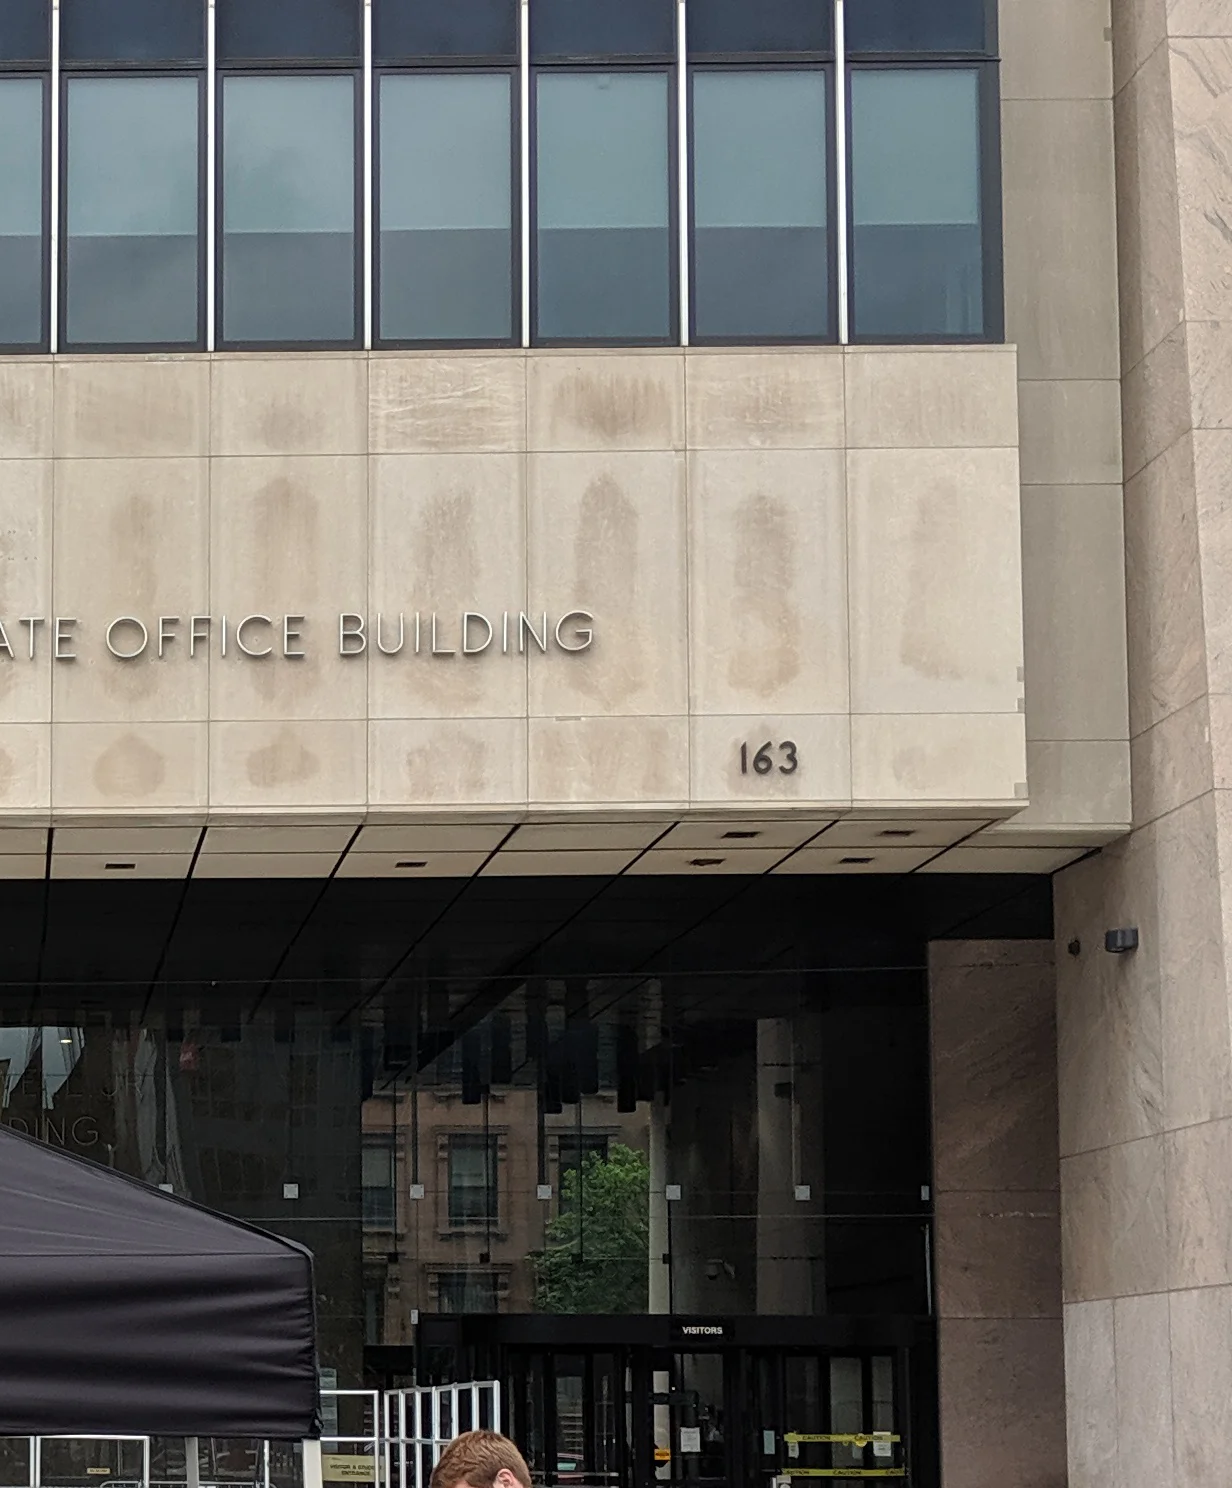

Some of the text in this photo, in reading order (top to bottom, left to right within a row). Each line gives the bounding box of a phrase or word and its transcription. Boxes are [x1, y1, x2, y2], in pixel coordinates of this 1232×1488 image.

[106, 614, 306, 659] OFFICE
[339, 610, 596, 656] BUILDING
[741, 741, 798, 776] 163
[682, 1326, 723, 1334] VISITORS
[802, 1434, 831, 1442] CAUTION
